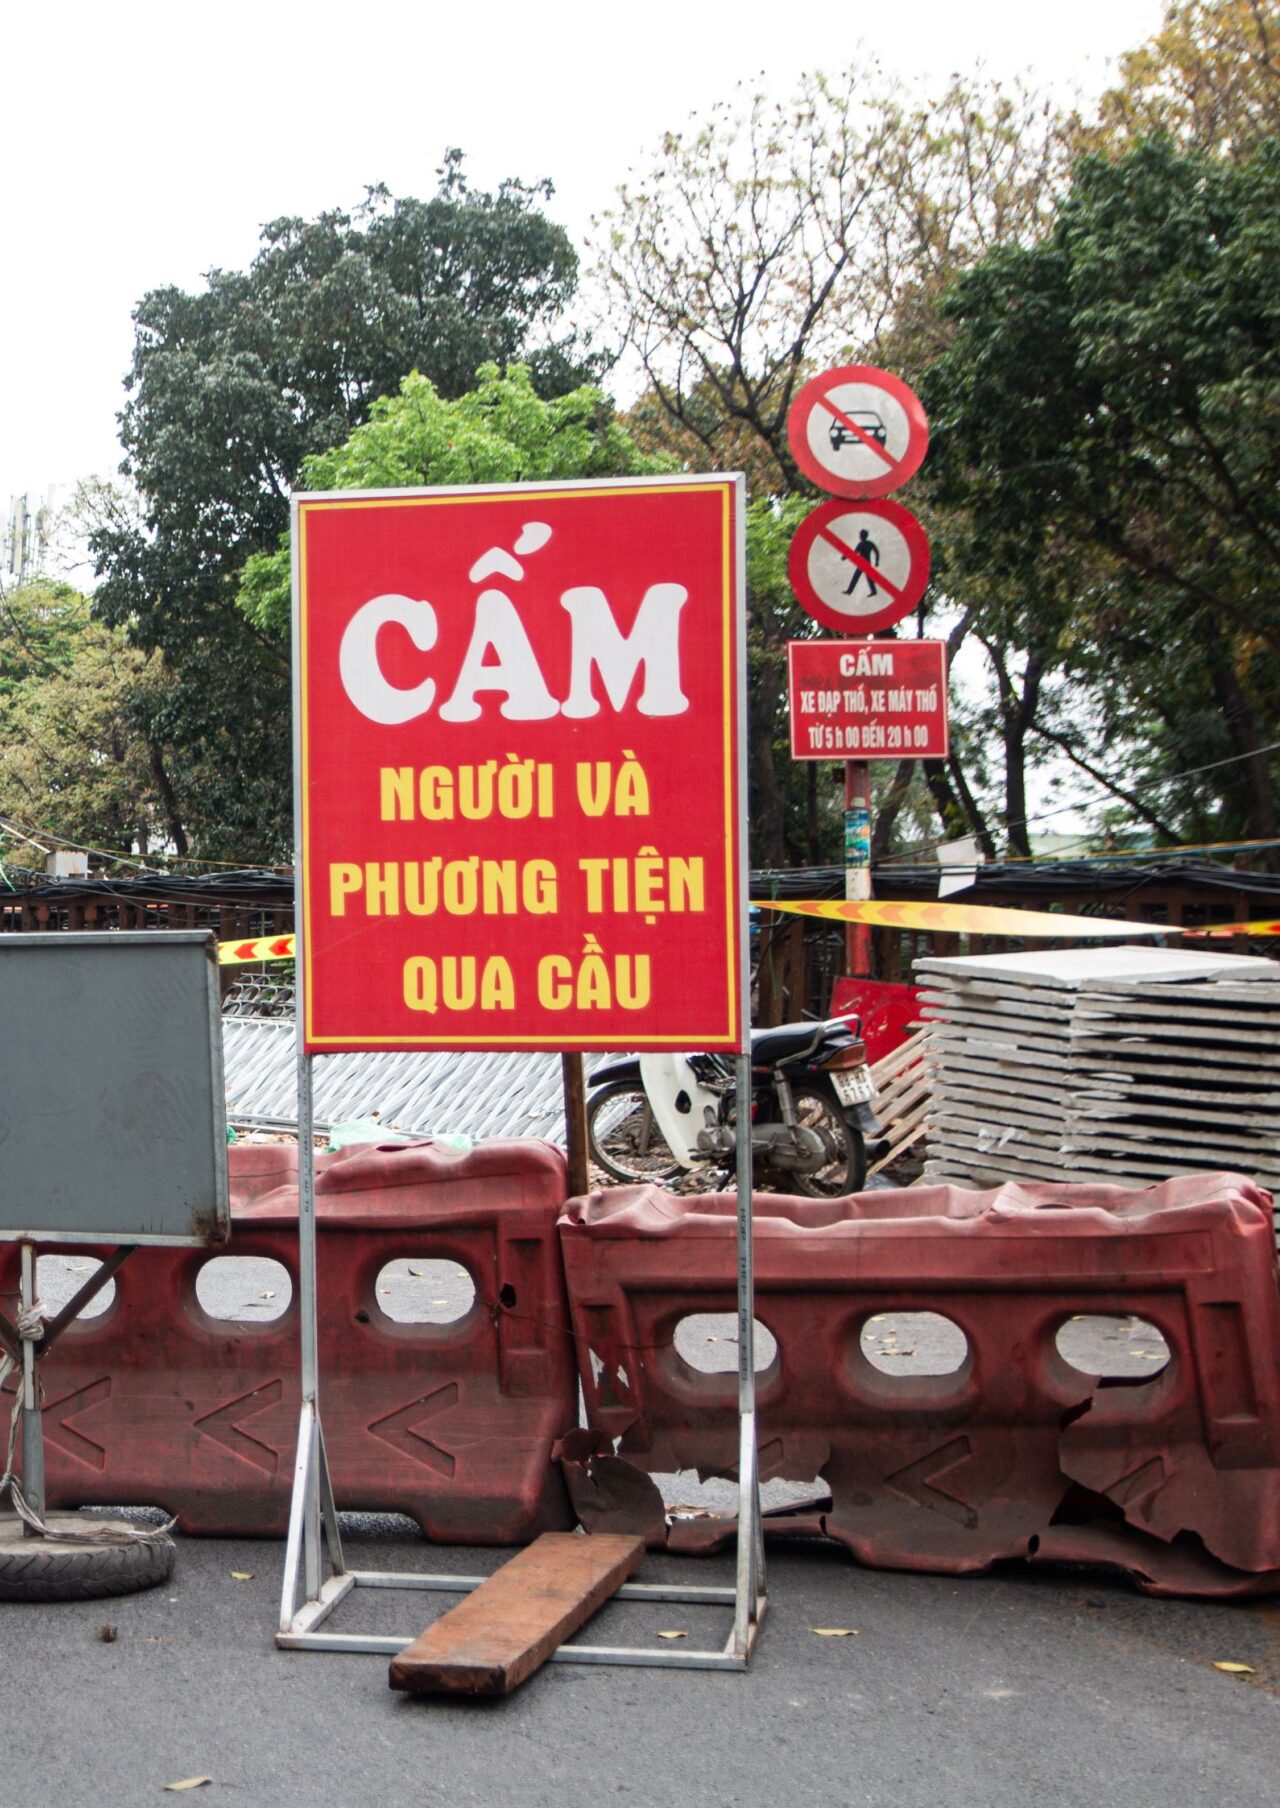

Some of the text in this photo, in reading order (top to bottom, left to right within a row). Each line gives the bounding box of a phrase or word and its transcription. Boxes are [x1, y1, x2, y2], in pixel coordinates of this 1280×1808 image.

[339, 521, 690, 725] CẤM
[839, 646, 894, 677] CẤM
[800, 690, 815, 713] XE
[817, 690, 841, 718] ĐẠP
[871, 690, 886, 712] XE
[888, 684, 913, 712] MÁY
[825, 727, 833, 749] 5
[835, 726, 843, 748] h
[845, 726, 859, 748] 00
[862, 718, 885, 748] ĐẾN
[887, 726, 901, 748] 20
[904, 725, 911, 748] h
[913, 725, 928, 748] 00
[381, 749, 650, 821] NGƯỜI VÀ
[329, 846, 705, 925] PHƯƠNG TIỆN
[402, 933, 651, 1014] QUA CẦU
